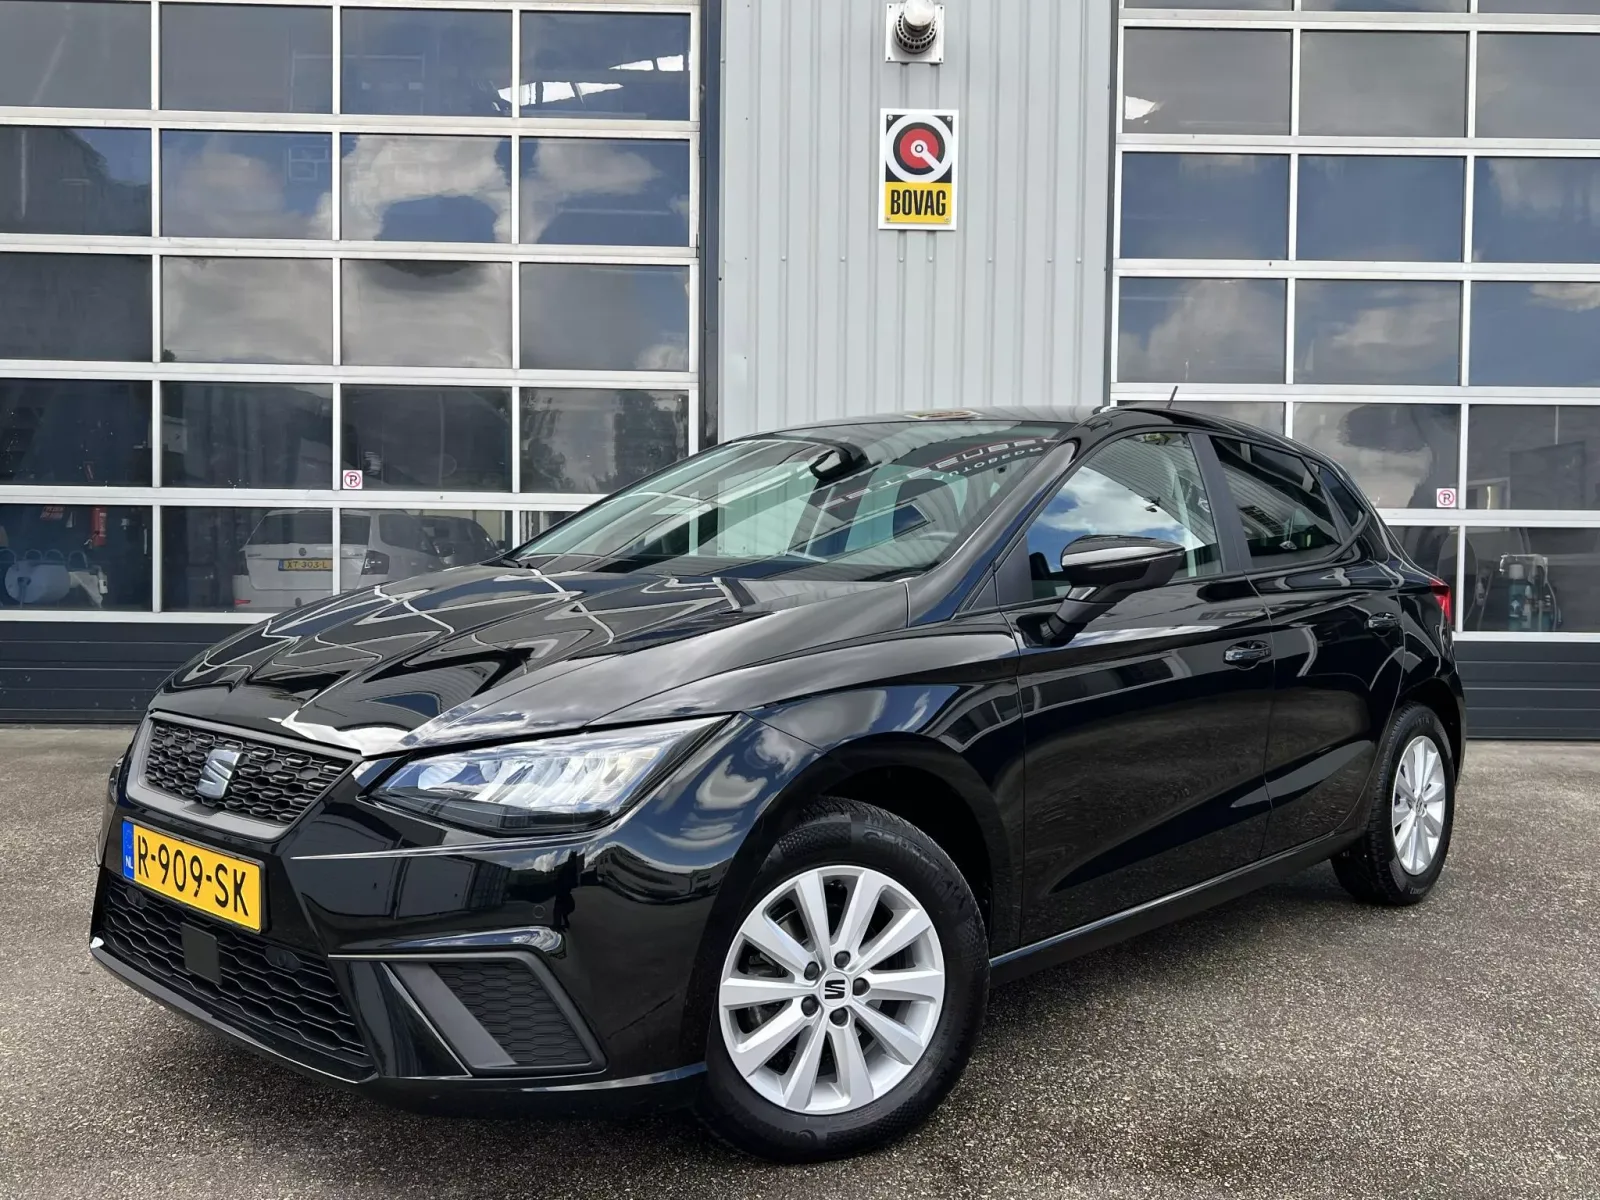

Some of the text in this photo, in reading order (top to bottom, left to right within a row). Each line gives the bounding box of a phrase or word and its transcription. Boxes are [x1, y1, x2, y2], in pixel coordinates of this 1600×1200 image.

[890, 189, 947, 216] BOVAG
[125, 855, 134, 870] NL
[137, 834, 250, 917] R-909-SK
